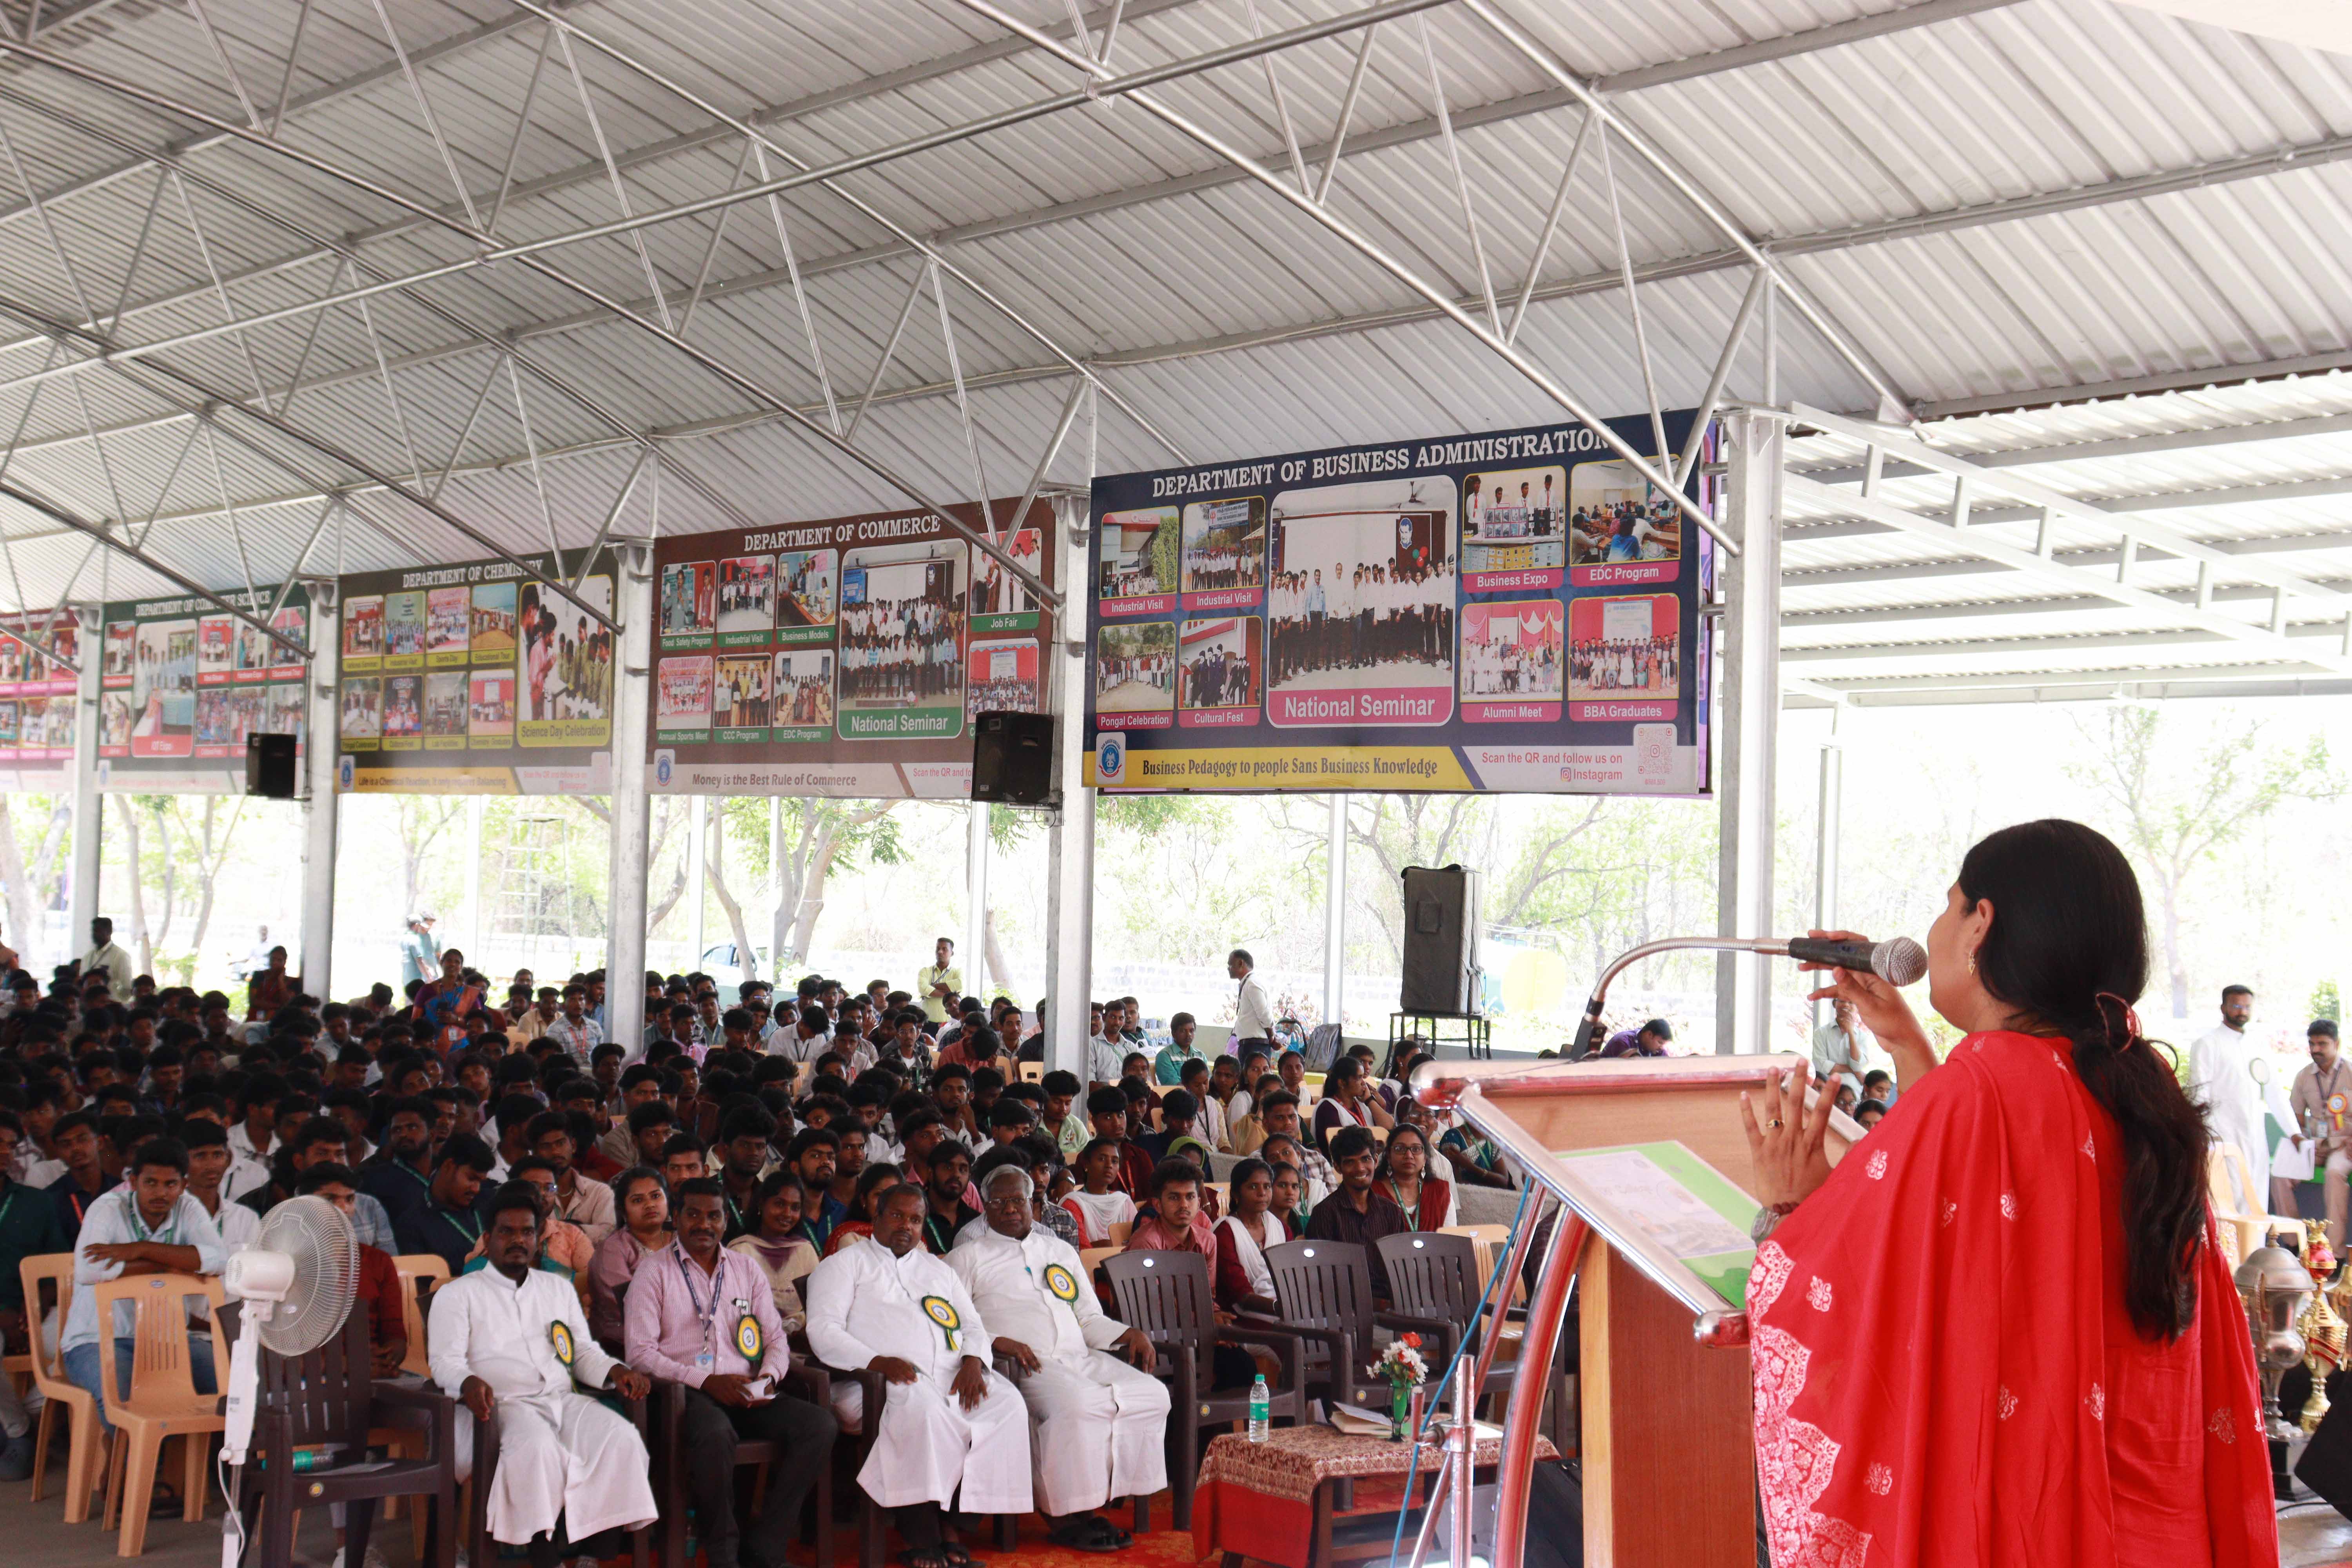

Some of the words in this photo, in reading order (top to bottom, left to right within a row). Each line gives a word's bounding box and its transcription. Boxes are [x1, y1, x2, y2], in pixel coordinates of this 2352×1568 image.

[1152, 463, 1275, 497] DEPARTMENT
[1281, 460, 1306, 483] OF
[1313, 448, 1410, 477] BUSINESS
[744, 526, 832, 552] DEPARTMENT
[836, 524, 854, 543] OF
[858, 515, 940, 539] COMMERCE
[403, 568, 465, 588] DEPARTMENT
[468, 566, 481, 581] OF
[1477, 574, 1521, 588] Business
[1523, 573, 1548, 586] Expo
[1590, 568, 1612, 581] EDC
[1615, 567, 1659, 580] Program
[136, 601, 182, 616] DEPARTMENT
[183, 599, 194, 612] OF
[238, 590, 270, 606] SCINCE
[1111, 601, 1145, 612] Industrial
[1147, 599, 1163, 610] Visit
[1196, 594, 1233, 606] Industrial
[1235, 592, 1252, 604] Visit
[991, 619, 1003, 629] Job
[1005, 618, 1018, 627] Fair
[676, 638, 690, 648] Safety
[691, 637, 711, 647] Program
[726, 635, 750, 644] Industrial
[782, 632, 807, 641] Business
[809, 631, 829, 640] Models
[1285, 695, 1355, 717] National
[1361, 693, 1436, 717] Seminar
[1483, 707, 1517, 718] Alumni
[1519, 706, 1542, 717] Meet
[1584, 706, 1606, 717] BBA
[1609, 705, 1662, 717] Graduates
[851, 715, 897, 732] National
[900, 714, 948, 731] Seminar
[1100, 715, 1125, 729] Pongal
[1127, 714, 1169, 726] Celebration
[1194, 713, 1225, 723] Cultural
[1227, 712, 1243, 722] Fest
[521, 726, 548, 737] Science
[550, 725, 563, 739] Day
[565, 724, 605, 736] Celebration
[677, 732, 694, 741] Sports
[695, 731, 708, 740] Meet
[723, 731, 734, 740] CCC
[736, 731, 759, 740] Program
[784, 730, 795, 739] EDC
[797, 730, 821, 739] Program
[1482, 752, 1505, 764] Scan
[1508, 752, 1522, 763] the
[1525, 752, 1540, 764] QR
[1543, 752, 1560, 763] and
[1563, 752, 1593, 763] follow
[1595, 755, 1608, 764] us
[1611, 755, 1622, 764] on
[913, 768, 928, 777] Scan
[930, 768, 939, 777] the
[941, 768, 951, 777] QR
[952, 768, 964, 777] and
[1142, 760, 1185, 775] Business
[1188, 759, 1237, 778] Pedagogy
[1240, 760, 1250, 773] to
[1253, 758, 1288, 777] people
[1292, 757, 1317, 773] Sans
[1321, 757, 1370, 773] Business
[1373, 757, 1437, 778] Knowledge
[693, 773, 722, 788] Money
[724, 773, 731, 785] is
[733, 773, 748, 785] the
[750, 773, 769, 785] Best
[772, 773, 792, 785] Rule
[795, 773, 805, 785] of
[806, 773, 857, 786] Commerce
[1574, 768, 1622, 782] Instagram
